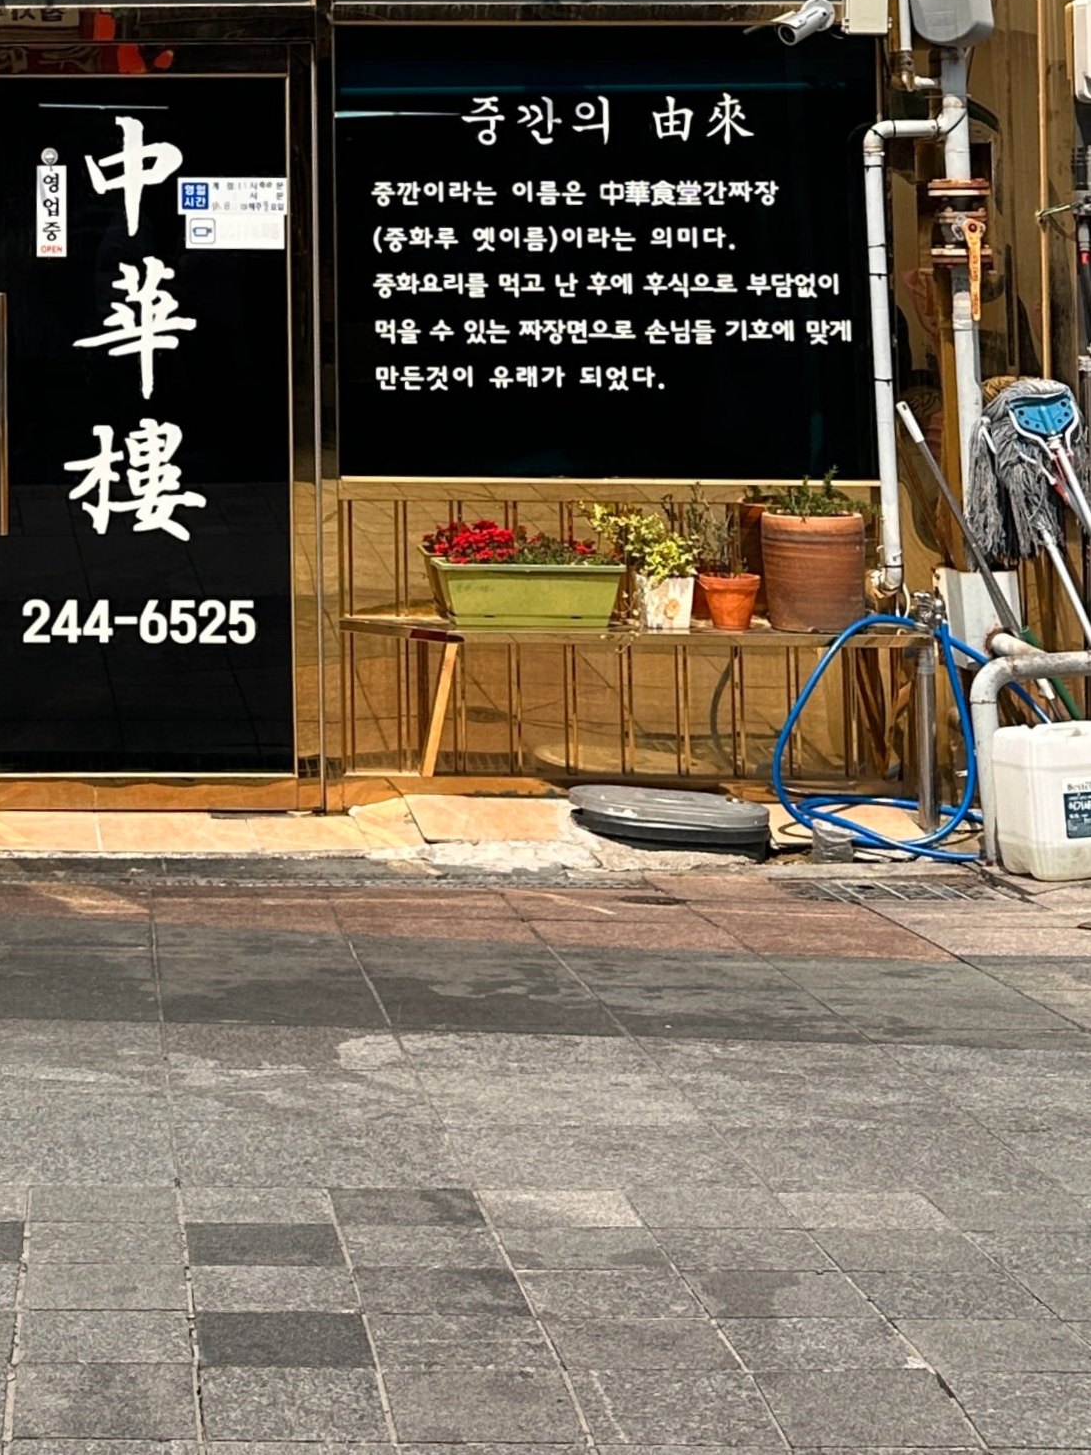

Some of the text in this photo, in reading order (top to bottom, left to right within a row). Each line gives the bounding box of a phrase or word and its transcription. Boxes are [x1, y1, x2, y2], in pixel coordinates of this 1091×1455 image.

[461, 92, 755, 146] 중깐의 由來
[184, 184, 207, 196] 영업
[184, 196, 207, 208] 시간
[371, 179, 779, 207] 중깐이라는 이름은 中華食堂간짜장
[42, 172, 62, 242] 영업중
[41, 245, 63, 253] OPEN
[372, 225, 736, 254] (중화루 옛이름)이라는 의미다.
[372, 271, 840, 299] 중화요리를 먹고 난 후에 후식으로 부담없이
[63, 115, 207, 541] 中華樓
[374, 318, 852, 346] 먹을 수 있는 짜장면으로 손님들 기호에 맞게
[375, 365, 665, 392] 만든것이 유래가 되었다.
[22, 599, 256, 644] 244-6525
